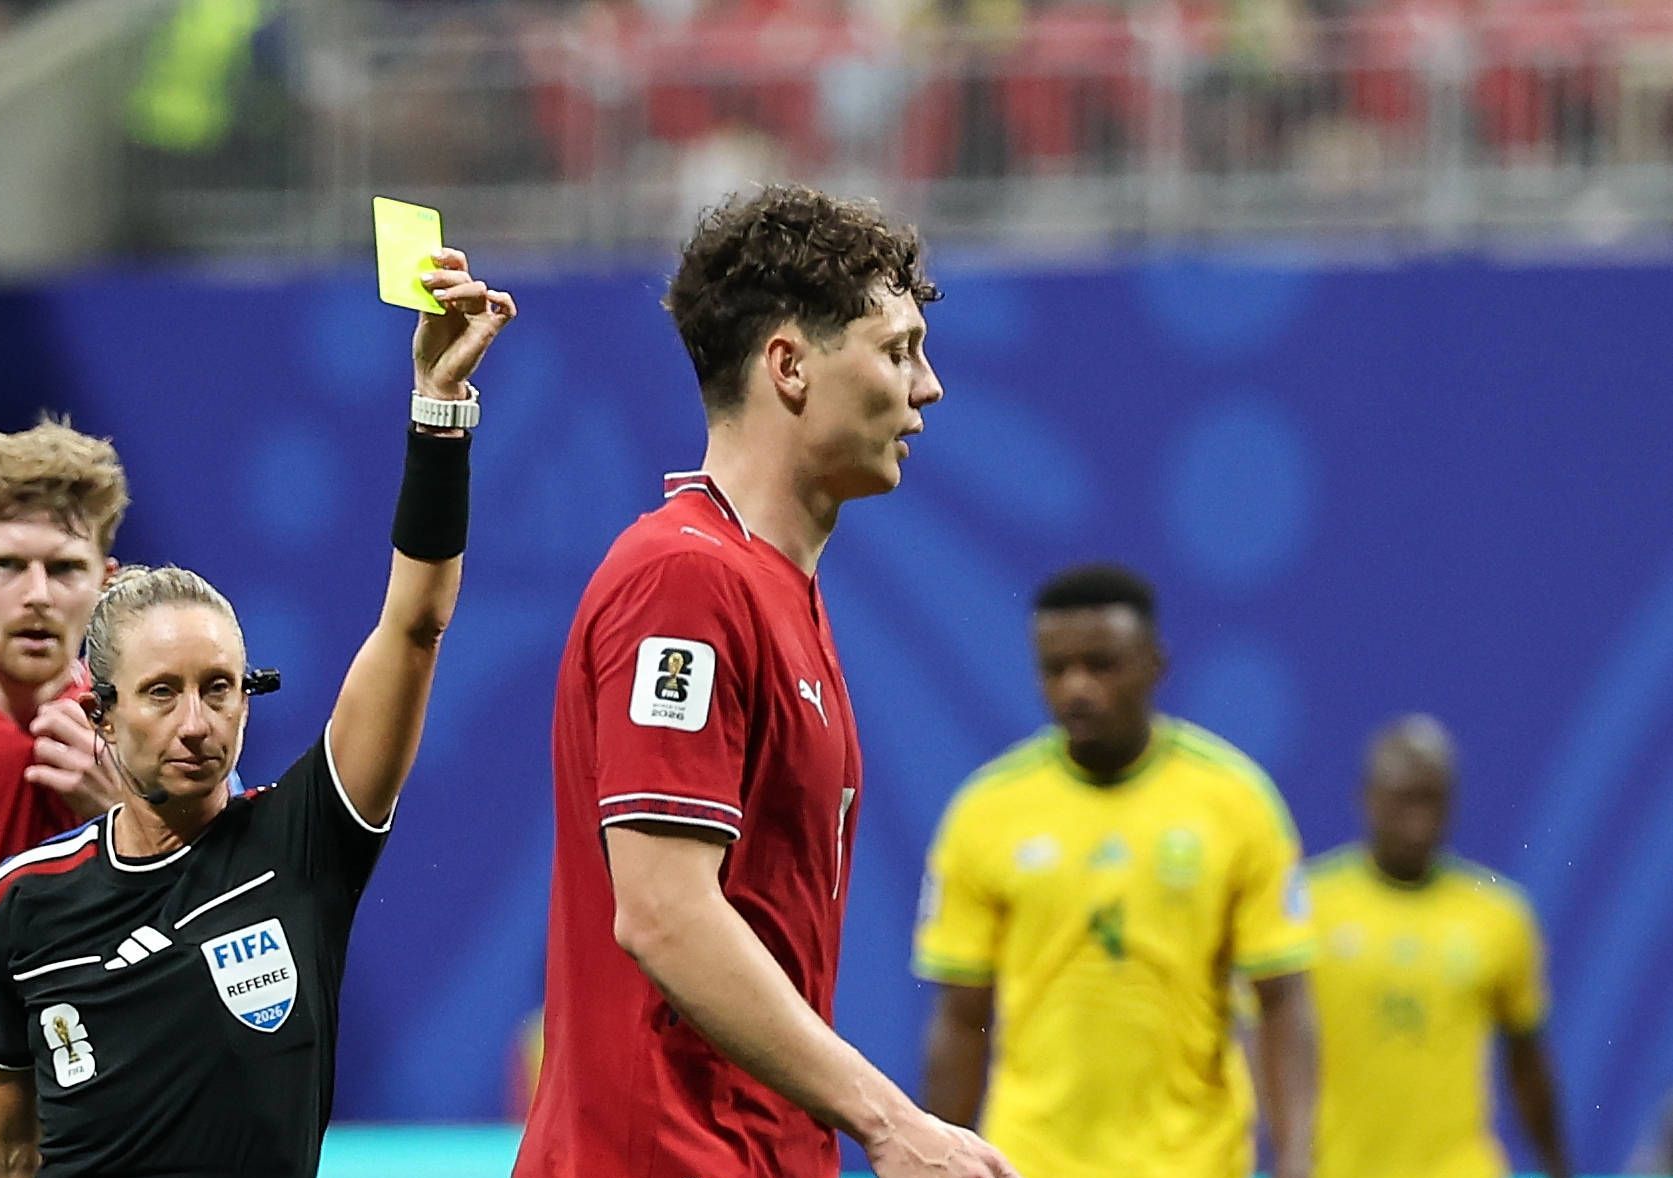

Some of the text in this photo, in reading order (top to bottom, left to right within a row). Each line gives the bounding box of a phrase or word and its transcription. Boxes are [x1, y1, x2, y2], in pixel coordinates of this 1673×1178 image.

[213, 930, 280, 970] FIFA
[227, 967, 290, 998] REFEREE
[253, 1004, 284, 1025] 2026
